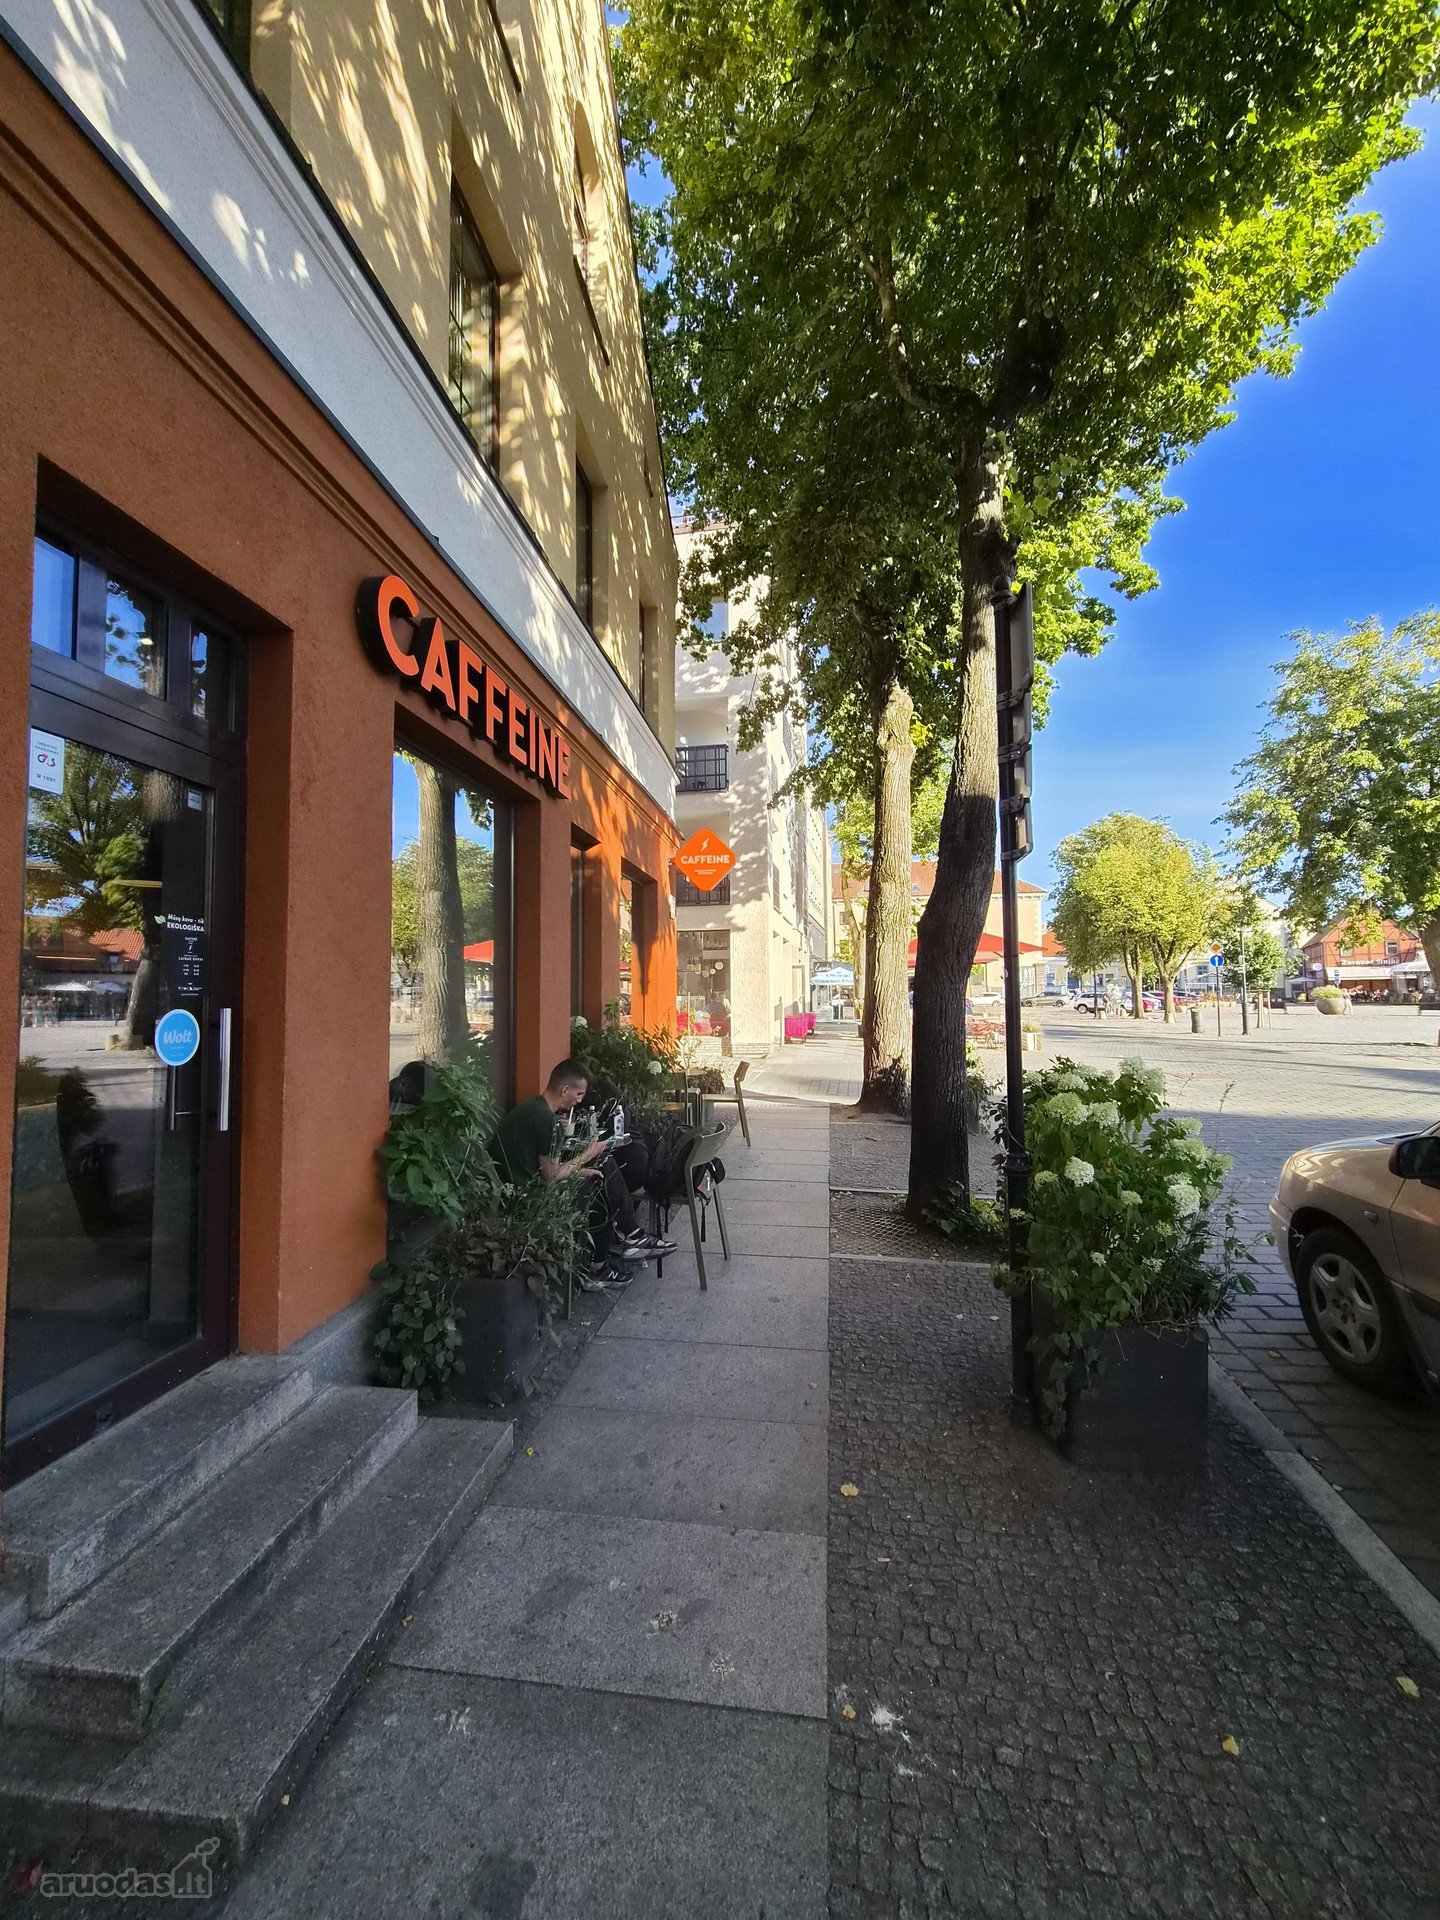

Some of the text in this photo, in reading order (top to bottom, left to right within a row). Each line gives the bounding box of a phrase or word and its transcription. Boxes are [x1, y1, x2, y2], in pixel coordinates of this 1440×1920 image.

[377, 574, 571, 799] CAFFEINE
[680, 854, 730, 865] CAFFEINE
[167, 921, 205, 932] EKOLOGIŠKA
[163, 1029, 193, 1044] Wolt
